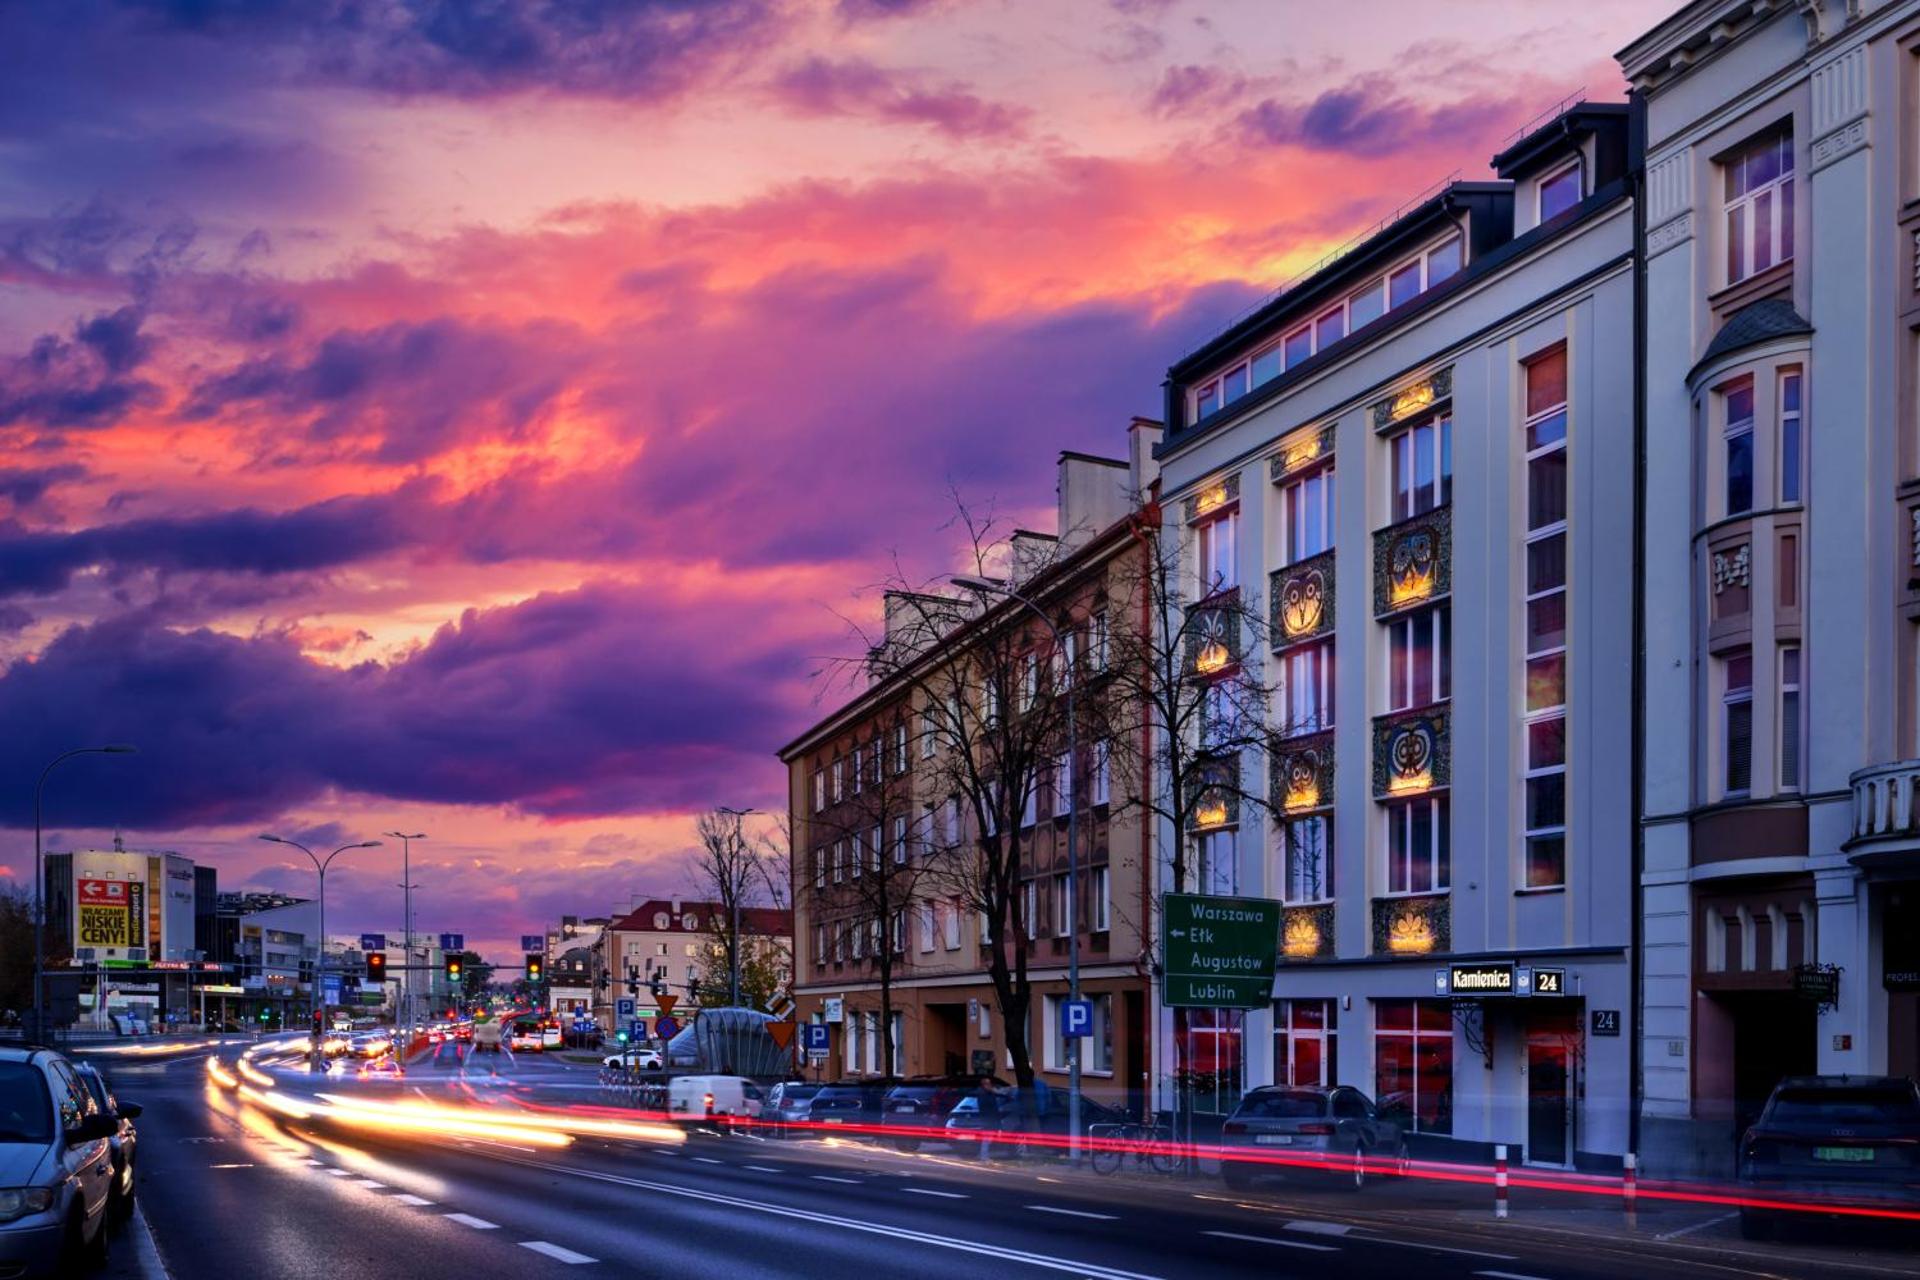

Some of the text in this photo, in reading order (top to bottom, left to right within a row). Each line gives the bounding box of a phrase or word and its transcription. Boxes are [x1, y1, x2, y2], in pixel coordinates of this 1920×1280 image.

[1191, 904, 1264, 922] Warszawa
[82, 915, 126, 929] NISKIE
[82, 928, 126, 944] CENY!
[1190, 927, 1214, 943] Ełk
[1191, 952, 1262, 972] Augustów
[1453, 969, 1557, 991] Kamienica 24
[1190, 983, 1235, 999] Lublin
[621, 1001, 631, 1013] P
[1069, 1004, 1087, 1032] P
[1596, 1011, 1614, 1029] 24
[635, 1022, 644, 1035] P
[812, 1028, 825, 1045] P
